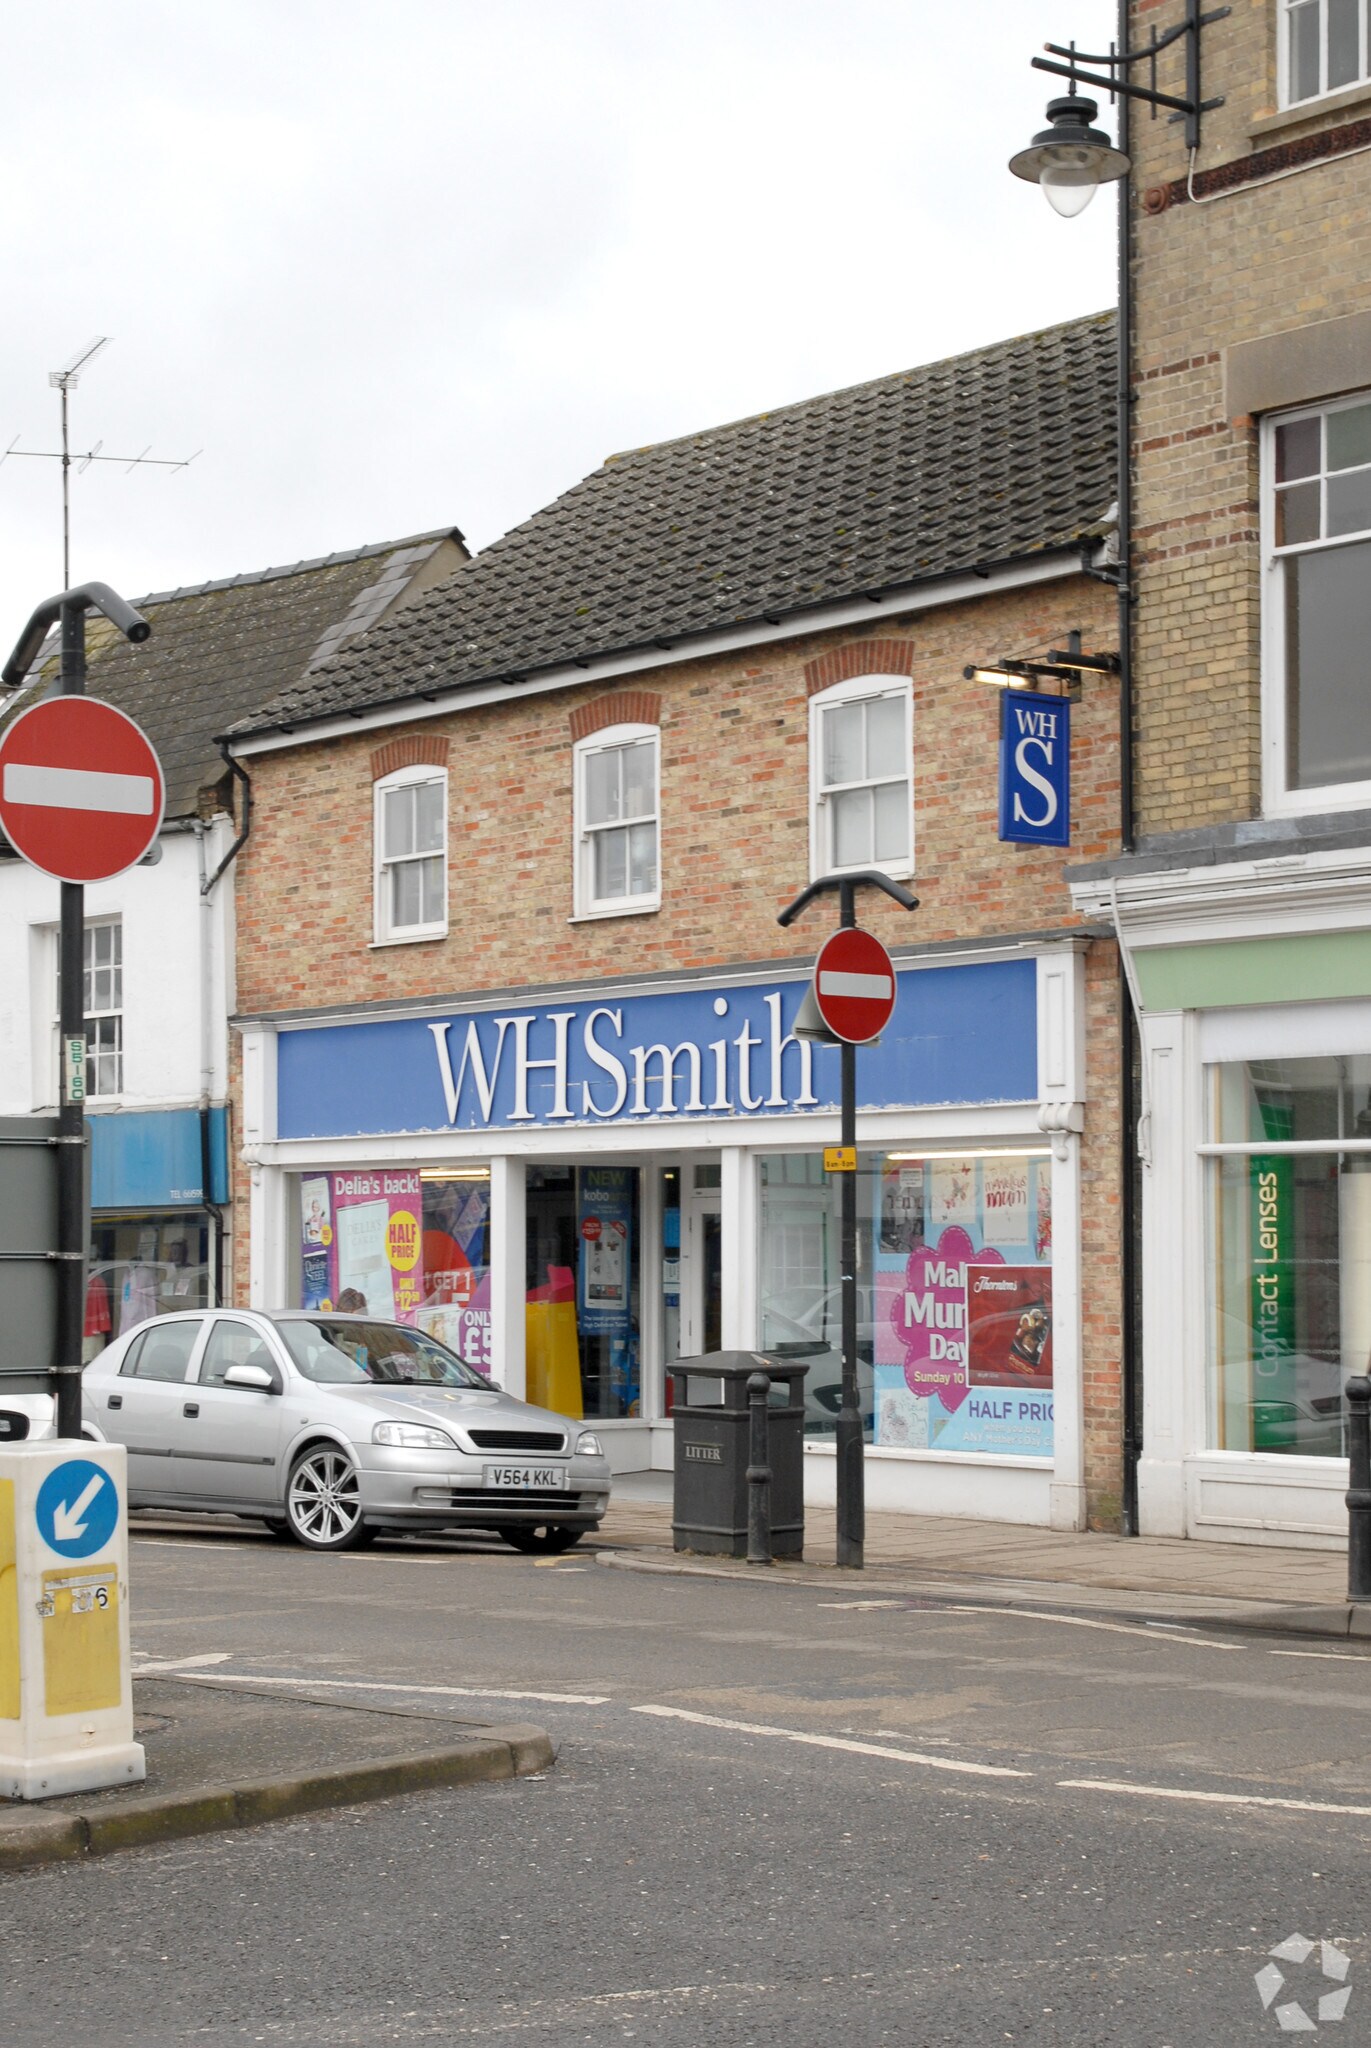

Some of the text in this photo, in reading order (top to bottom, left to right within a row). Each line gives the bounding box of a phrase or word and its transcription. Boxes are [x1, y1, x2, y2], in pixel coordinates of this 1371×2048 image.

[1014, 708, 1058, 739] WH
[1013, 737, 1058, 827] S
[427, 991, 819, 1124] WHSmith
[335, 1176, 380, 1196] Delia's
[383, 1174, 420, 1195] back!
[587, 1170, 626, 1186] NEW
[583, 1189, 609, 1202] kobo
[389, 1223, 416, 1244] HALF
[391, 1245, 414, 1259] PRICE
[433, 1271, 460, 1290] GET
[1253, 1172, 1279, 1377] Contact Lenses
[914, 1371, 950, 1385] Sunday
[953, 1372, 965, 1384] 10
[969, 1400, 1013, 1419] HALF
[685, 1446, 721, 1460] LITTER
[493, 1469, 557, 1486] V564 KKL
